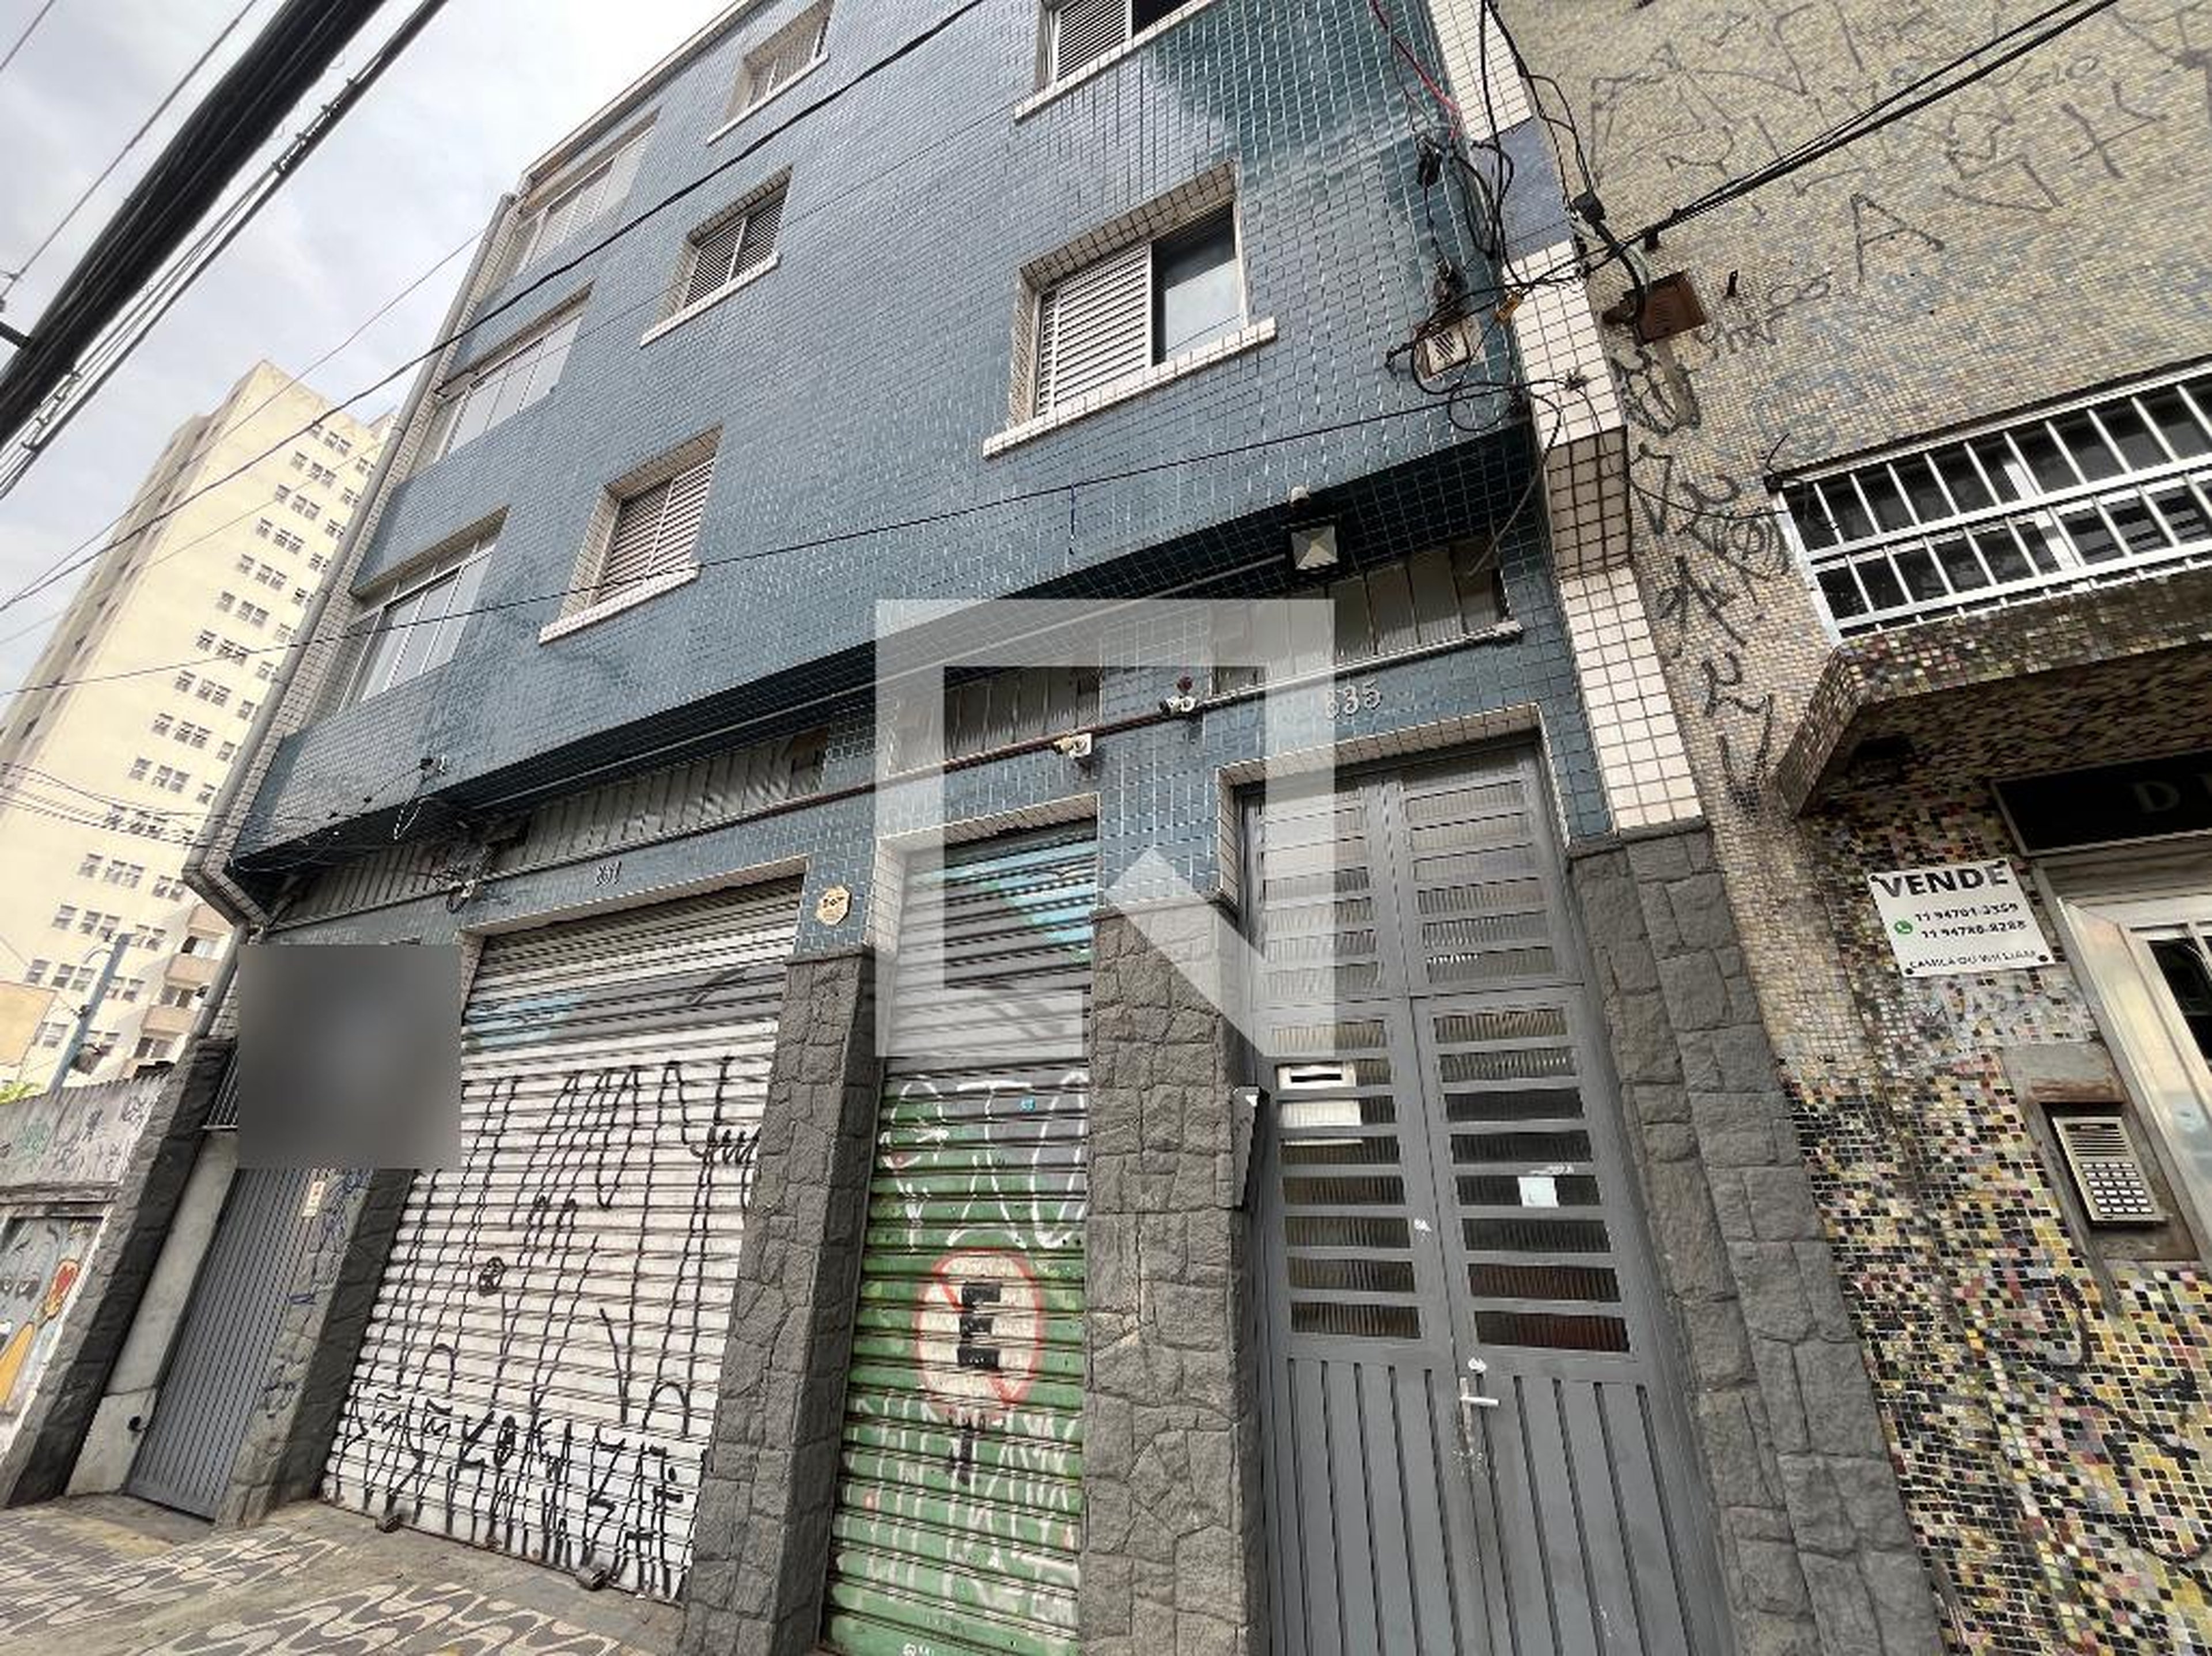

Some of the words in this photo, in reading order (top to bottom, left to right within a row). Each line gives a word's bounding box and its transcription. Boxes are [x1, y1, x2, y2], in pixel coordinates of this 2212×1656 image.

[1874, 863, 2009, 897] VENDE
[1915, 912, 1930, 922] 11
[1921, 930, 1937, 939] 11
